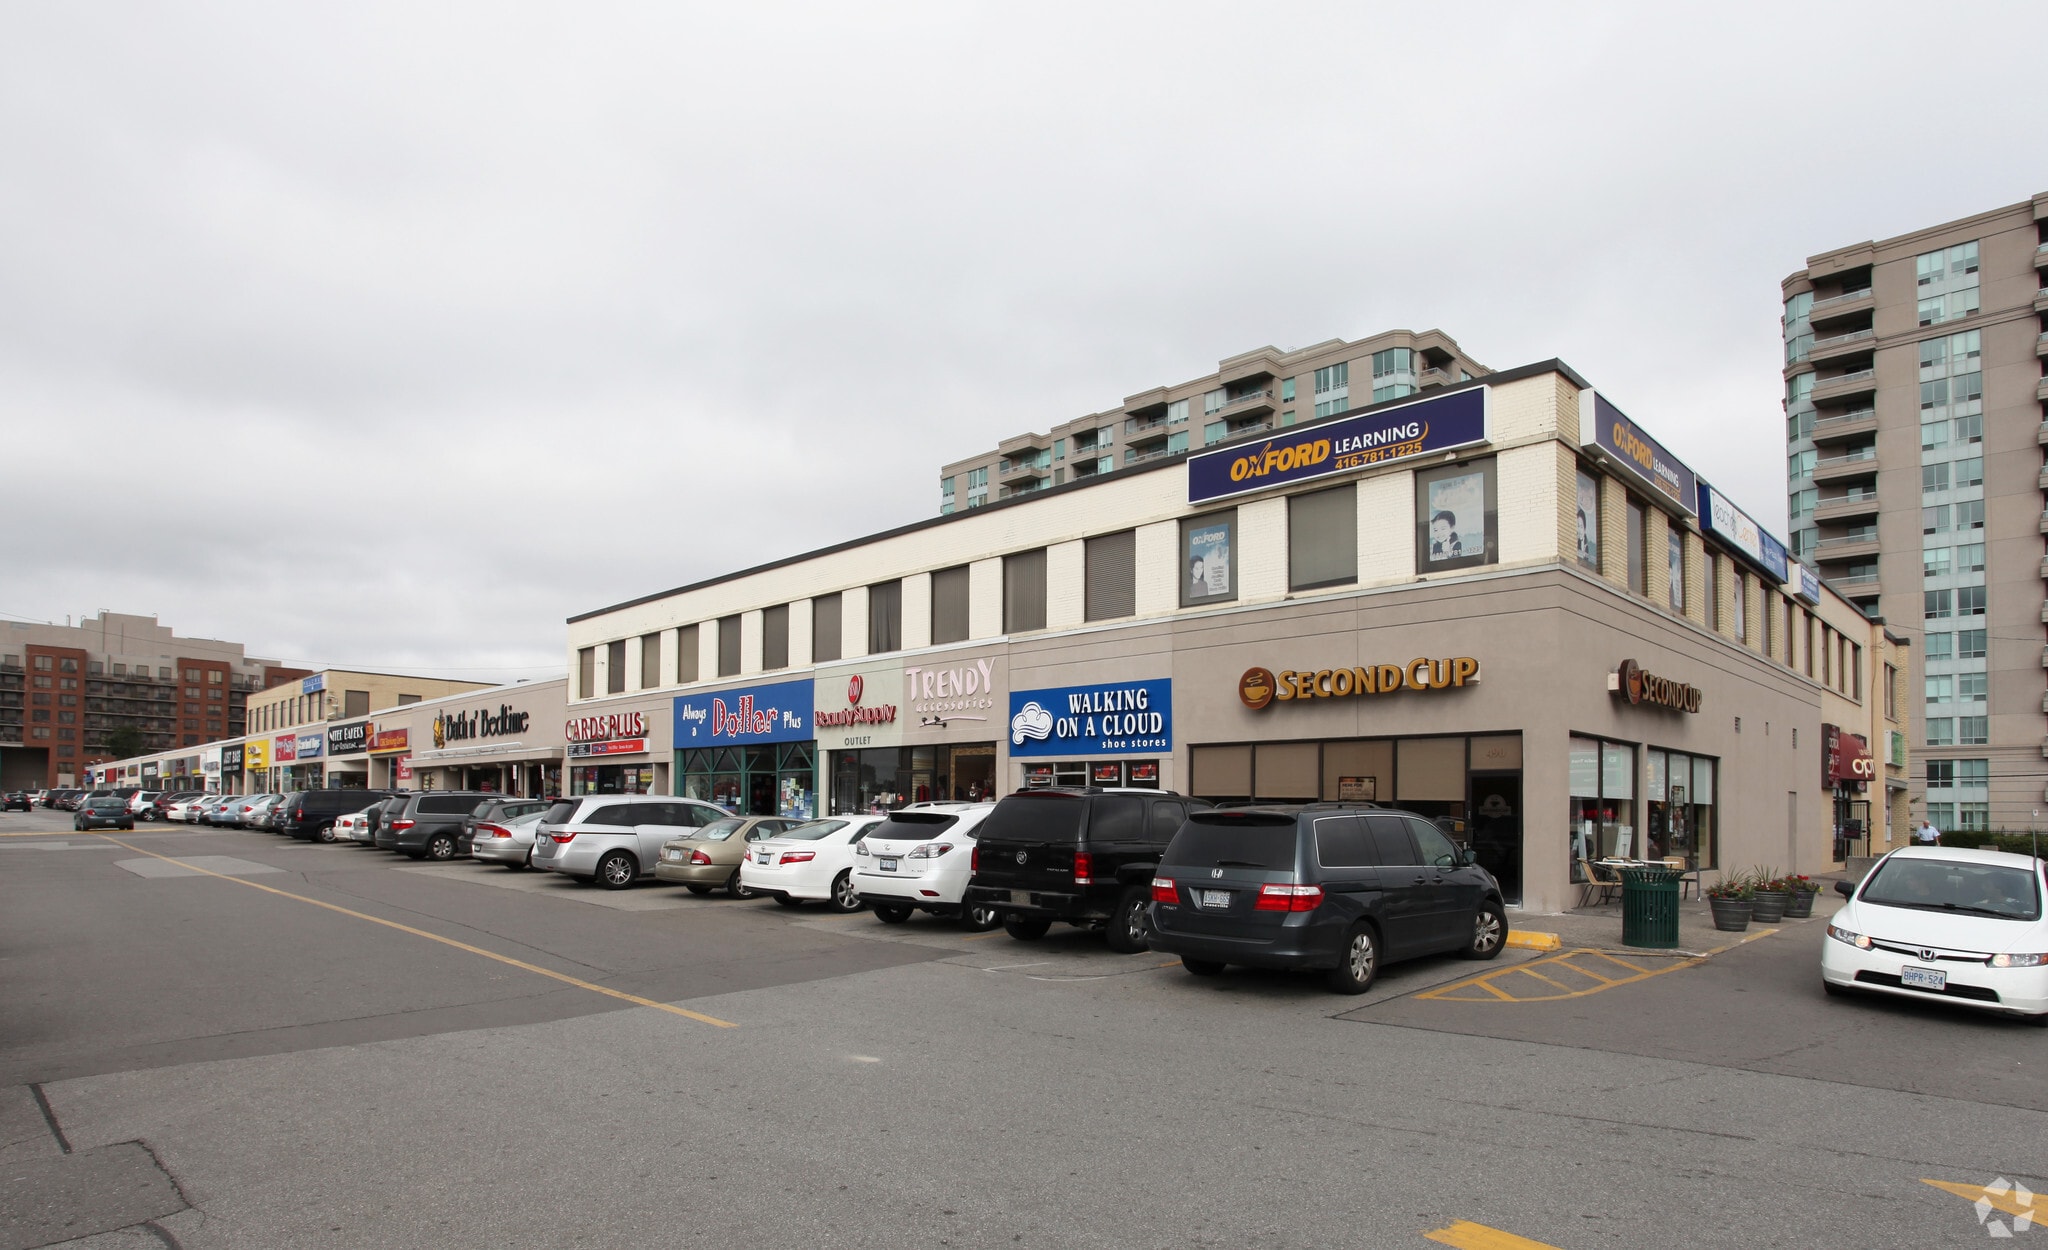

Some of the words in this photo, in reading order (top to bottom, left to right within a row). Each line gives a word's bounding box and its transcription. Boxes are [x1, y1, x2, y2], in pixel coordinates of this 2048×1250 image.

[1230, 439, 1331, 482] OXFORD
[1335, 422, 1420, 454] LEARNING
[1335, 442, 1422, 469] 416-781-1225
[1613, 422, 1653, 470] OXFORD
[1652, 457, 1680, 488] LEARNING
[1192, 531, 1226, 545] OXFORD
[905, 657, 997, 701] TRENDY
[1277, 663, 1404, 701] SECOND
[1405, 656, 1479, 691] CUP
[1641, 669, 1684, 712] SECOND
[1682, 682, 1702, 713] CUP
[915, 697, 993, 713] accessories
[1068, 688, 1148, 714] WALKING
[445, 709, 468, 741] Bath
[480, 703, 530, 738] Bedtime
[565, 716, 606, 742] CARDS
[609, 711, 643, 740] PLUS
[682, 704, 707, 724] Always
[712, 694, 778, 738] Dollar
[783, 711, 802, 729] Plus
[1056, 716, 1079, 738] ON
[1085, 716, 1096, 737] A
[1102, 712, 1163, 736] CLOUD
[692, 727, 697, 737] a
[844, 735, 871, 746] OUTLET
[1102, 739, 1126, 749] shoe
[1131, 738, 1166, 748] stores
[1903, 971, 1924, 982] BHPR
[1928, 974, 1944, 985] 524
